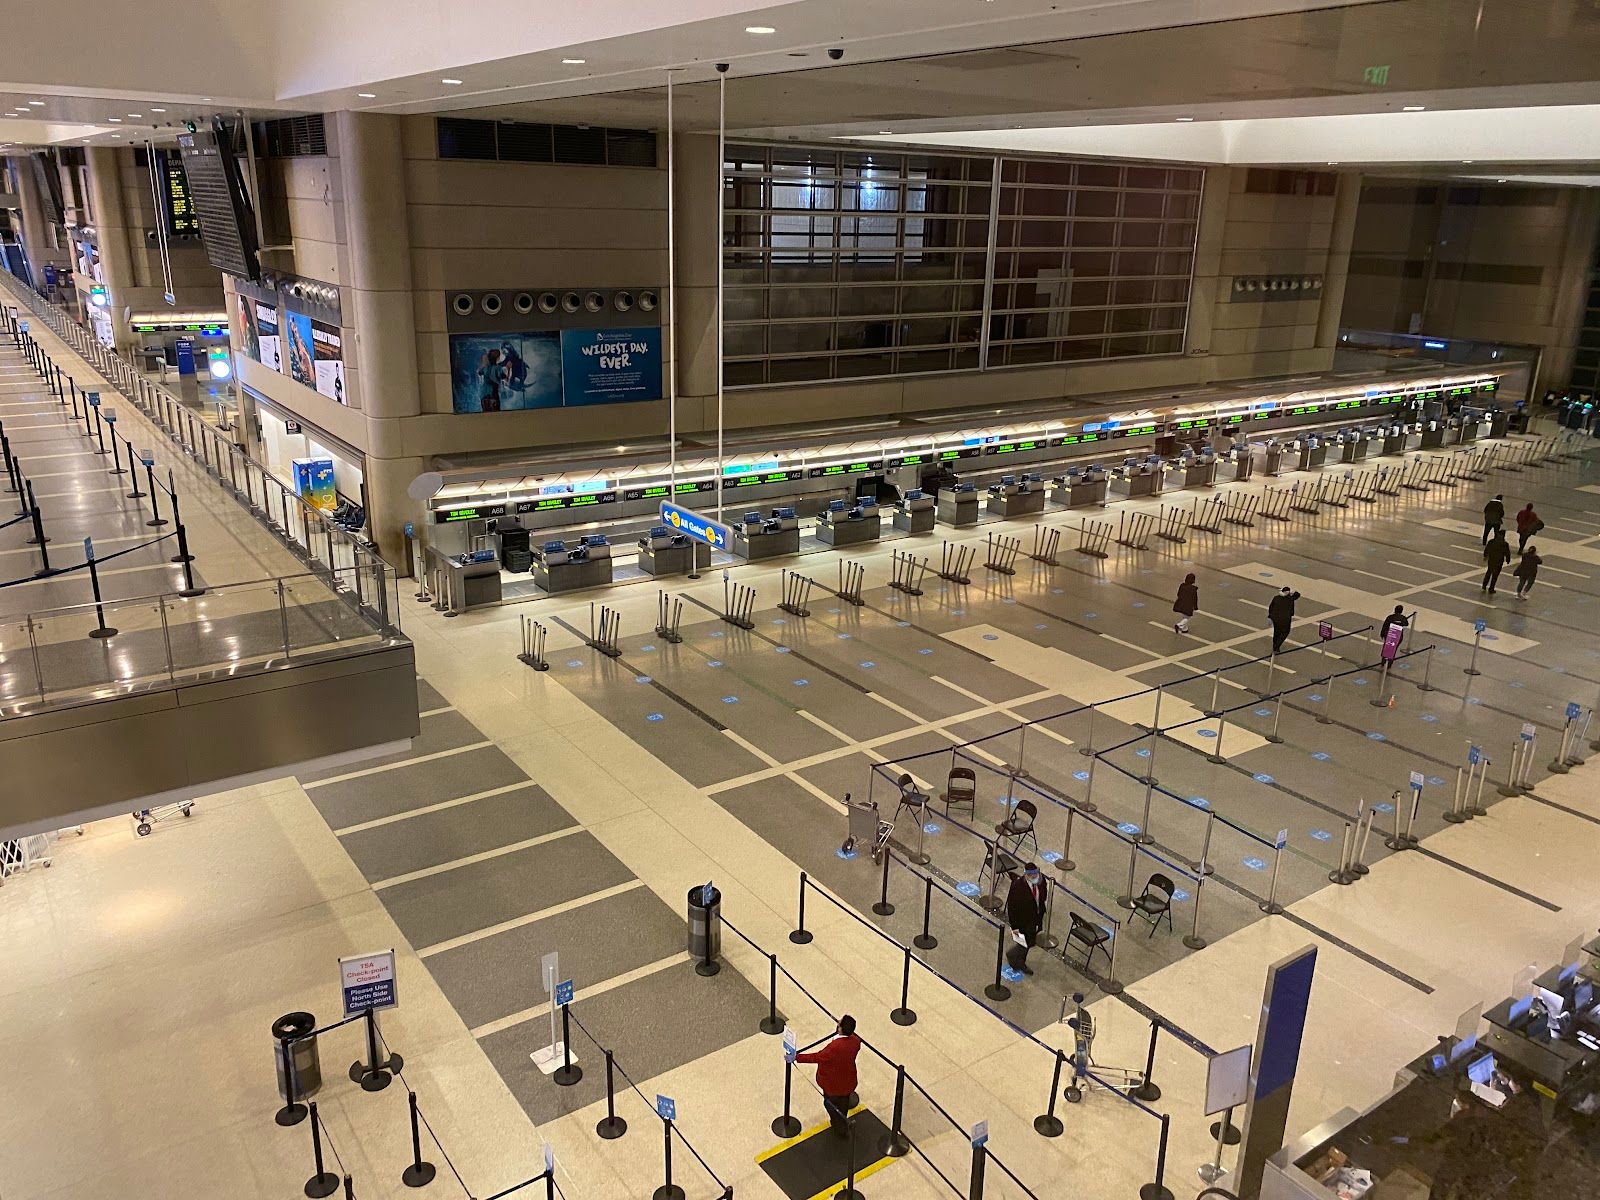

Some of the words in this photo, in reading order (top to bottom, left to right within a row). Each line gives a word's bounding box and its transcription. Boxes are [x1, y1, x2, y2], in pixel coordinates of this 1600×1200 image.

[1363, 65, 1391, 86] EXIT
[582, 342, 628, 355] WILDEST.
[630, 342, 648, 354] DAY.
[600, 353, 631, 369] EVER.
[680, 518, 689, 530] All
[688, 521, 707, 537] Gates
[357, 974, 380, 982] Closed
[350, 987, 374, 996] Please
[351, 994, 372, 1002] North
[372, 990, 388, 998] Side
[350, 996, 391, 1008] Check-point
